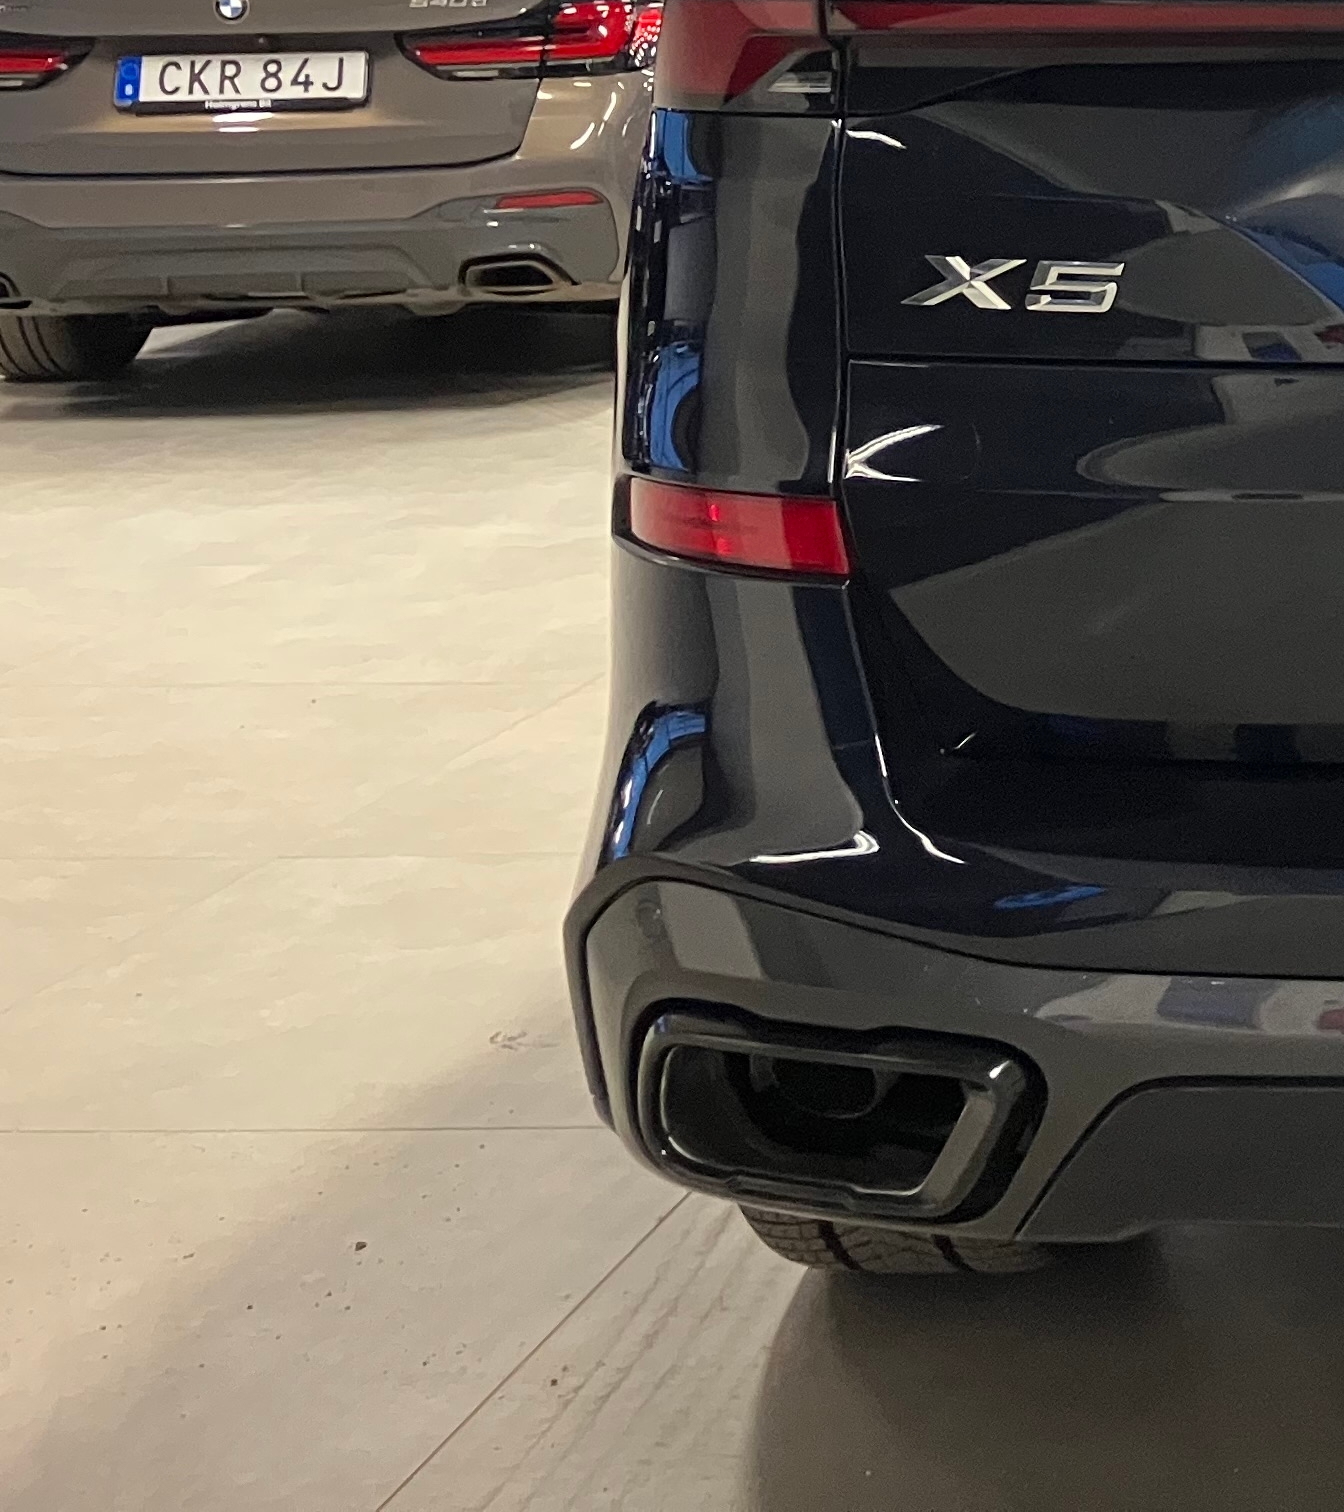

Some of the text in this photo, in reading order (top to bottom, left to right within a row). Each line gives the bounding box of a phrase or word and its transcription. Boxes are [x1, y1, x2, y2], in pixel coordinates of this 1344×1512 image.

[158, 57, 345, 96] CKR 84J
[900, 254, 1125, 314] X5
